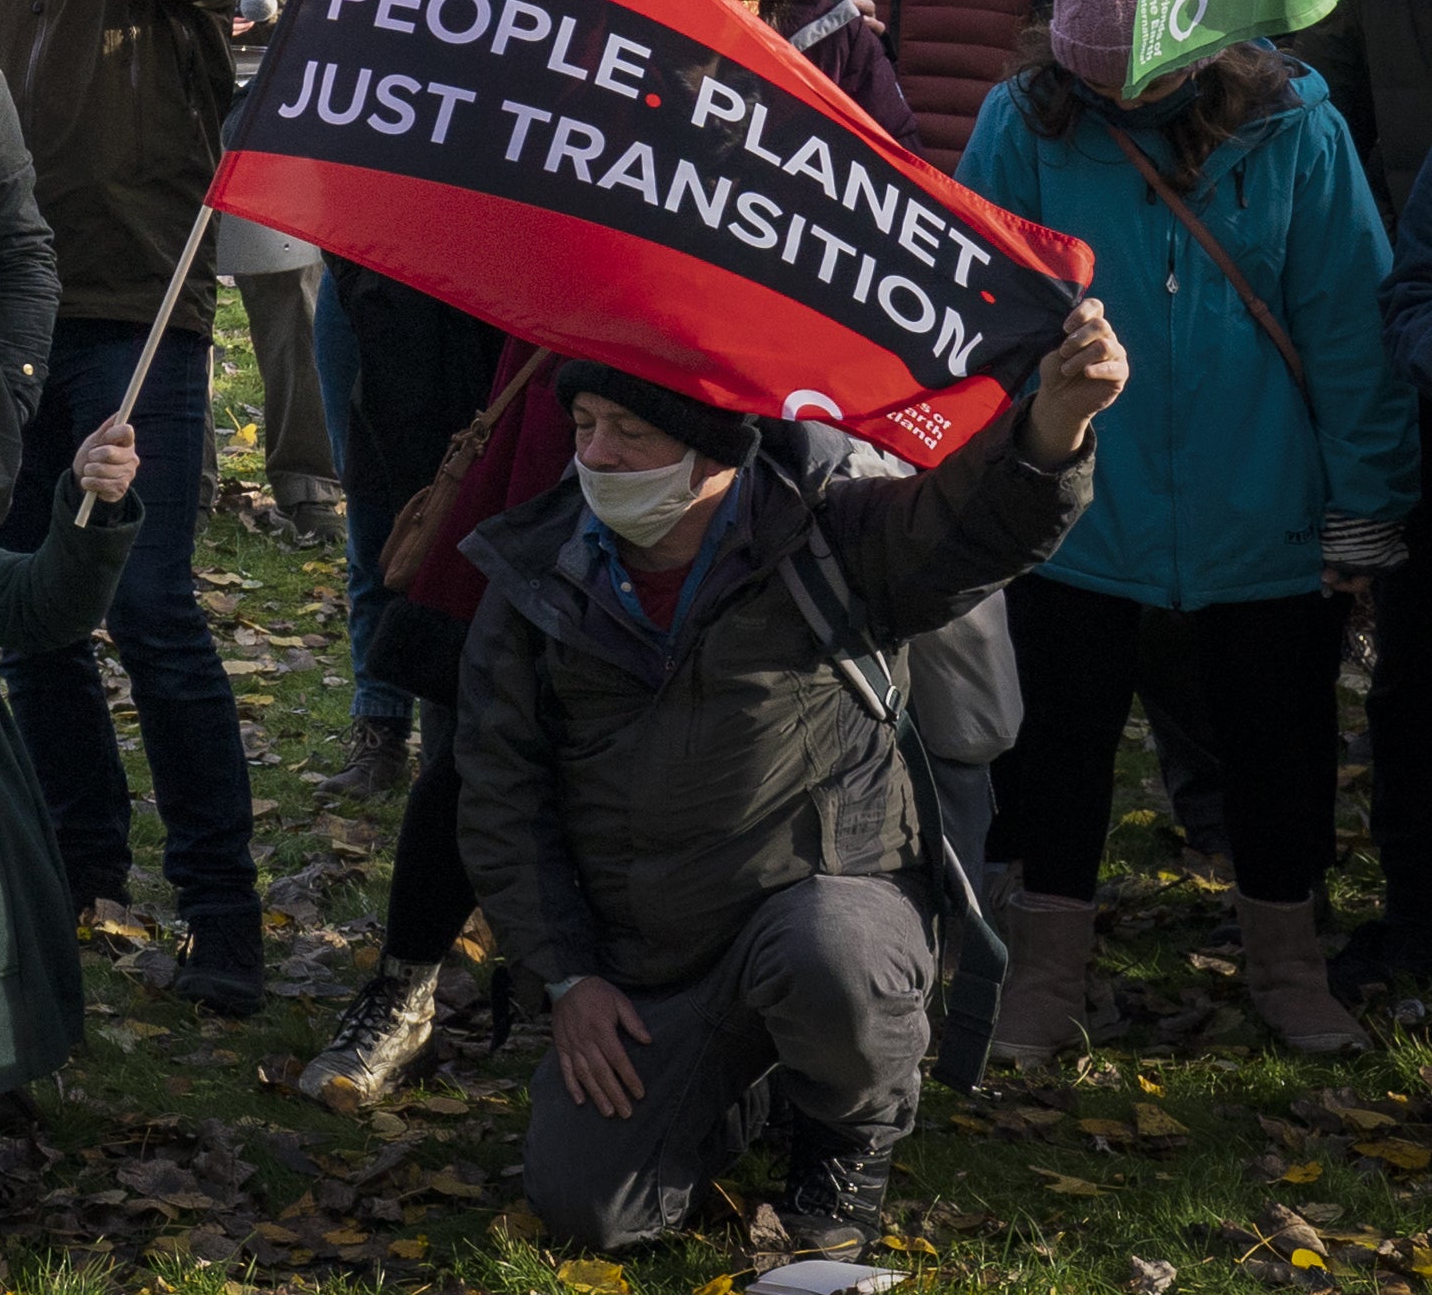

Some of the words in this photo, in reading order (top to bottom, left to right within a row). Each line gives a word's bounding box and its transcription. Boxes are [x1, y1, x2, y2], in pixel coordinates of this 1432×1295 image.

[278, 60, 475, 145] JUST
[501, 99, 985, 377] TRANSITION
[691, 76, 996, 304] PLANET.
[904, 405, 944, 441] arth
